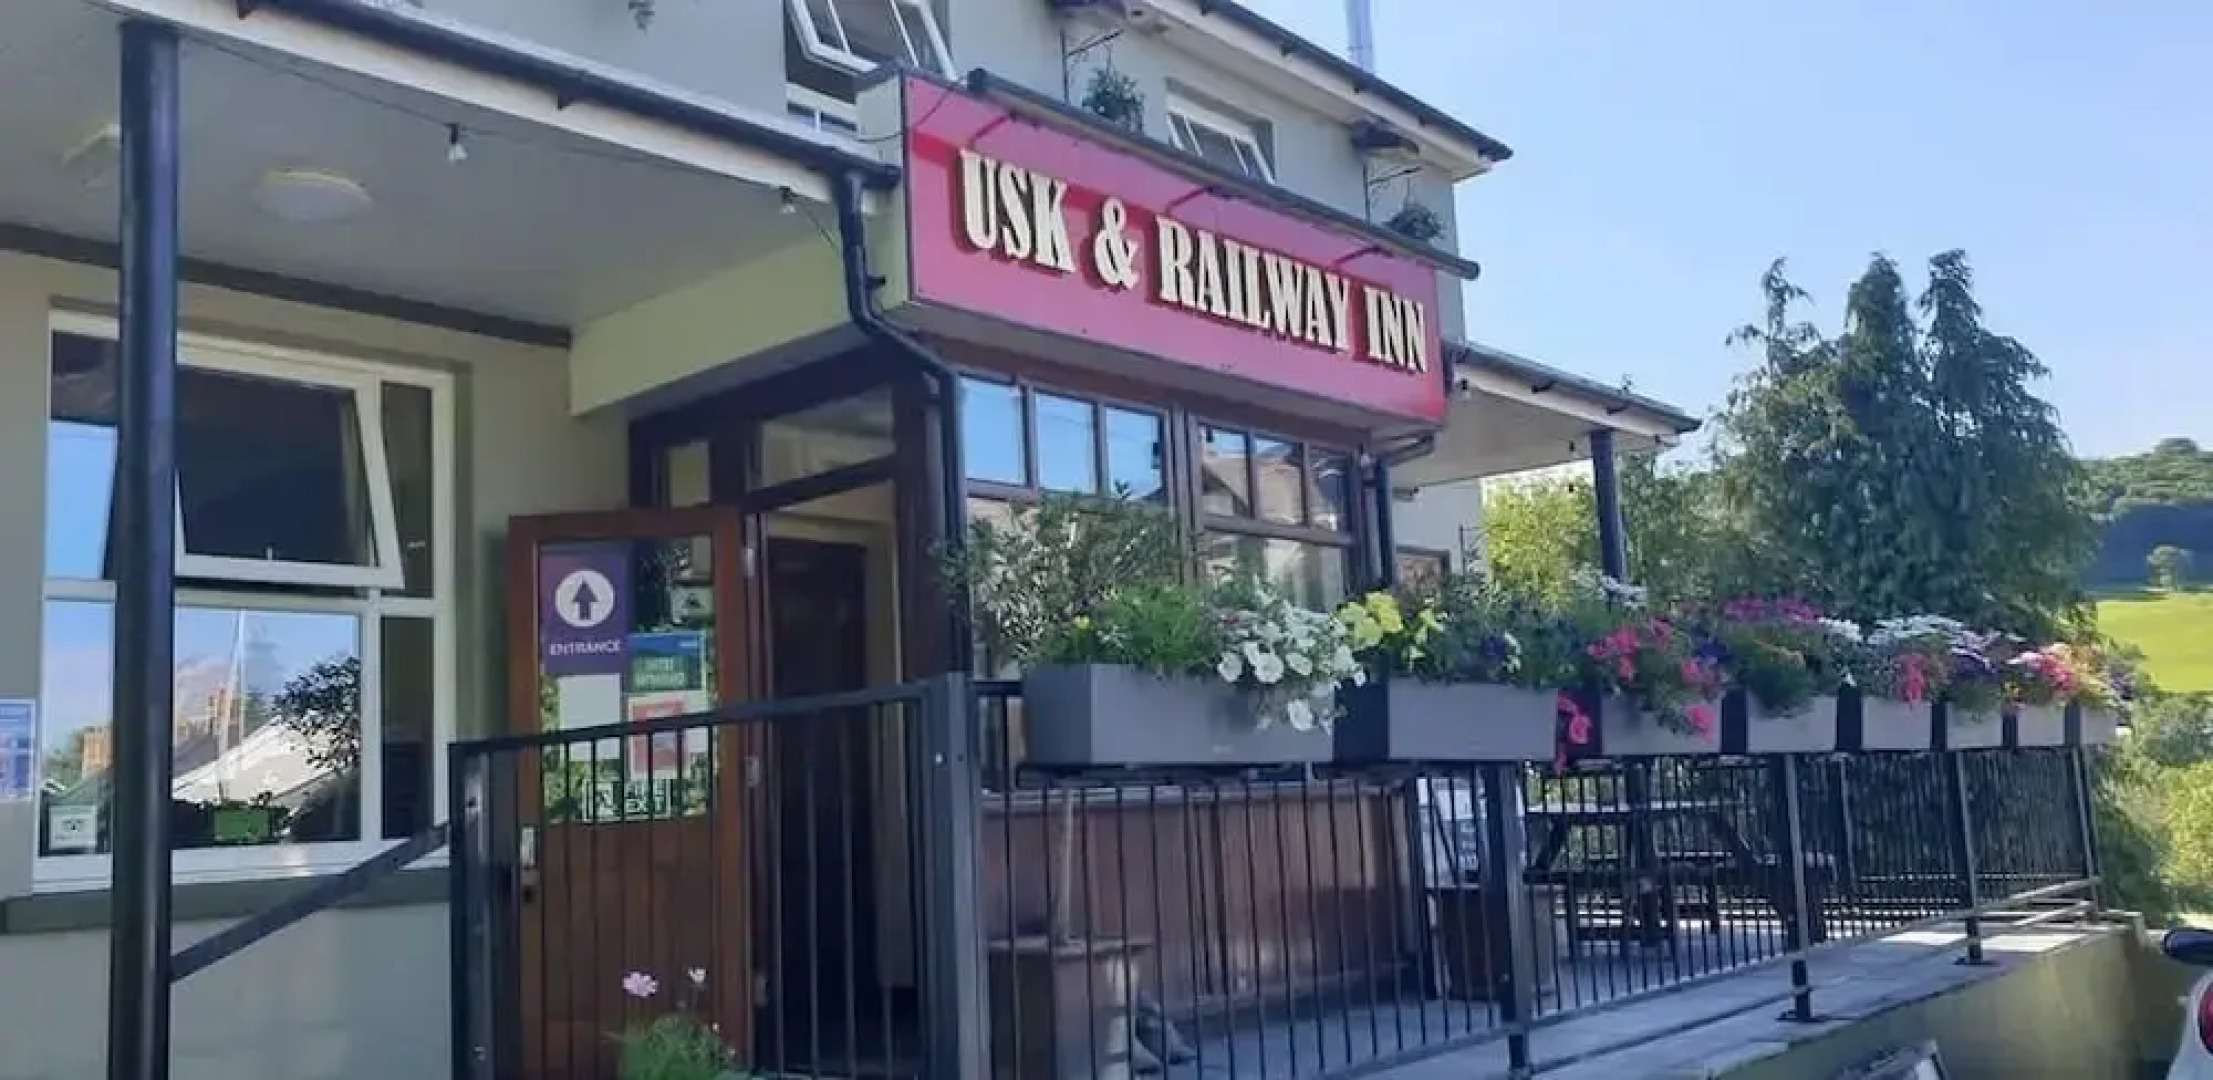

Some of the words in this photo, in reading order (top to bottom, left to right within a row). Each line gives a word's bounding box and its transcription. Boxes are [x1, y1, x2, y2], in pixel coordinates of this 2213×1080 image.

[958, 148, 1076, 273] USK
[1094, 197, 1140, 289] &
[1155, 213, 1349, 350] RAILWAY
[1363, 285, 1427, 374] INN
[549, 639, 621, 656] ENTRANCE
[625, 798, 665, 813] EXT
